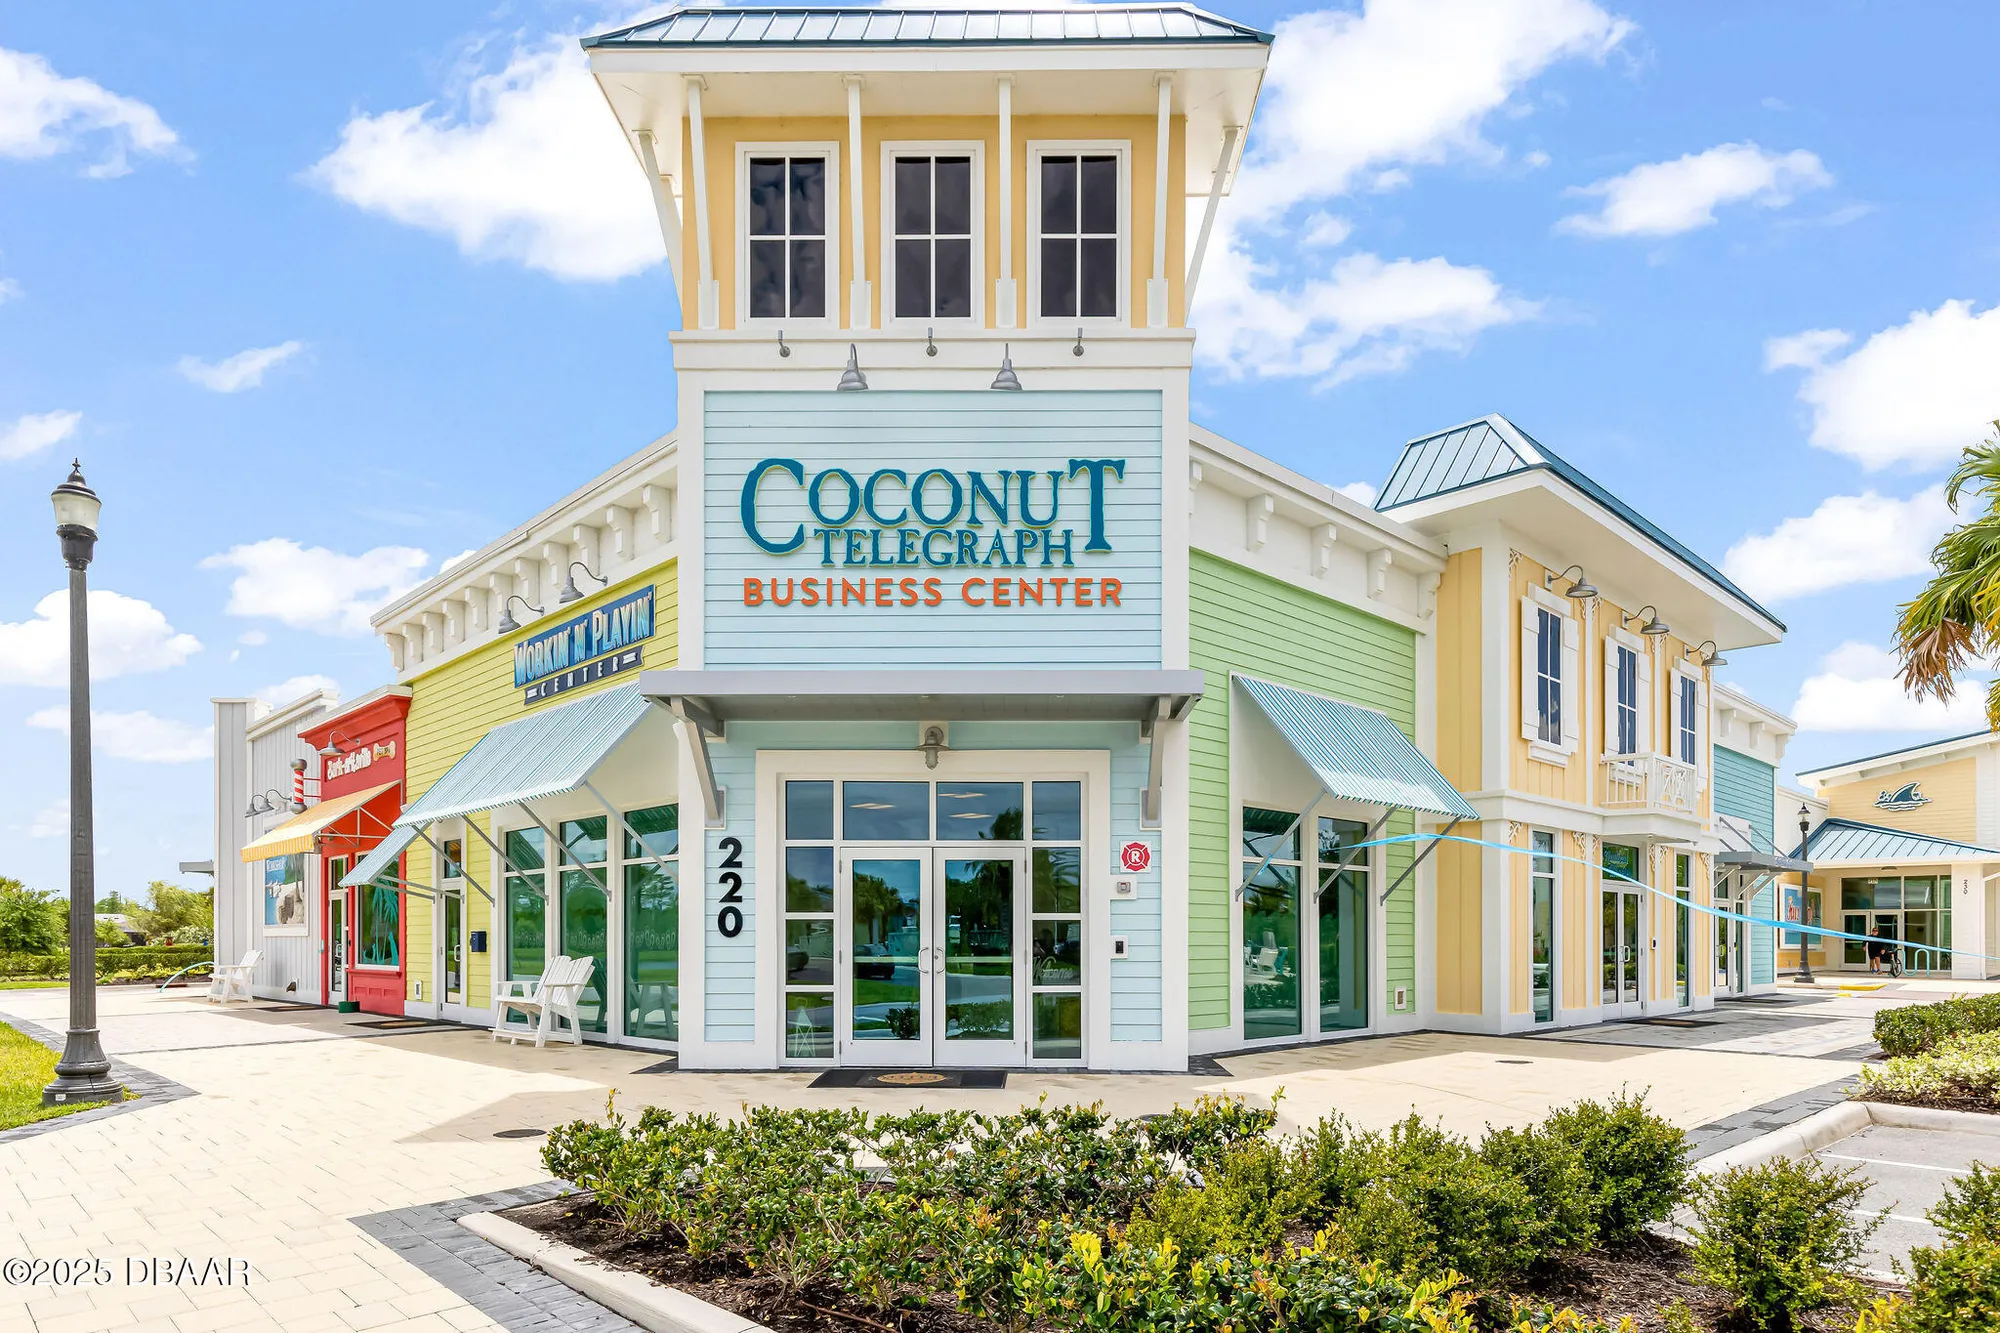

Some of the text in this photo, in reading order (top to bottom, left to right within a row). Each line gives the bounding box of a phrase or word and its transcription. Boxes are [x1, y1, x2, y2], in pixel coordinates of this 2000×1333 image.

[813, 527, 1076, 568] TELEGRAPH
[743, 577, 1123, 607] BUSINESS CENTER
[540, 656, 619, 697] CENTER
[1131, 850, 1141, 863] R
[718, 836, 744, 939] 220
